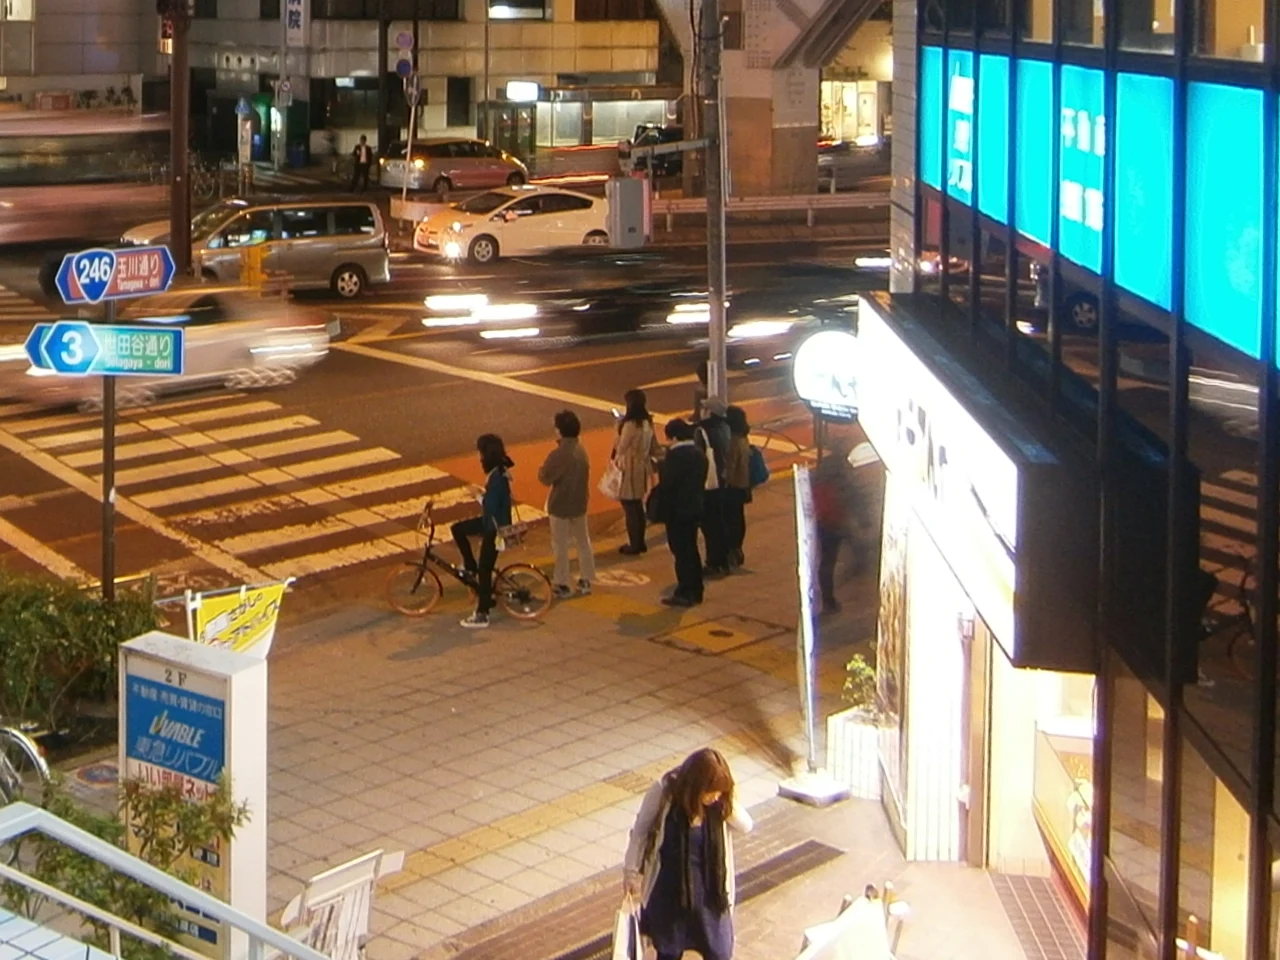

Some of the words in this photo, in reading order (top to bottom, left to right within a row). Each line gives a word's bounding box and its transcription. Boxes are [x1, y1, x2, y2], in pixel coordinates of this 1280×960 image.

[79, 256, 111, 284] 246
[117, 253, 160, 279] 玉川通り
[60, 331, 83, 365] 3
[104, 333, 172, 356] 世田谷通り
[154, 356, 171, 369] dori
[133, 735, 220, 781] 東急リバブル
